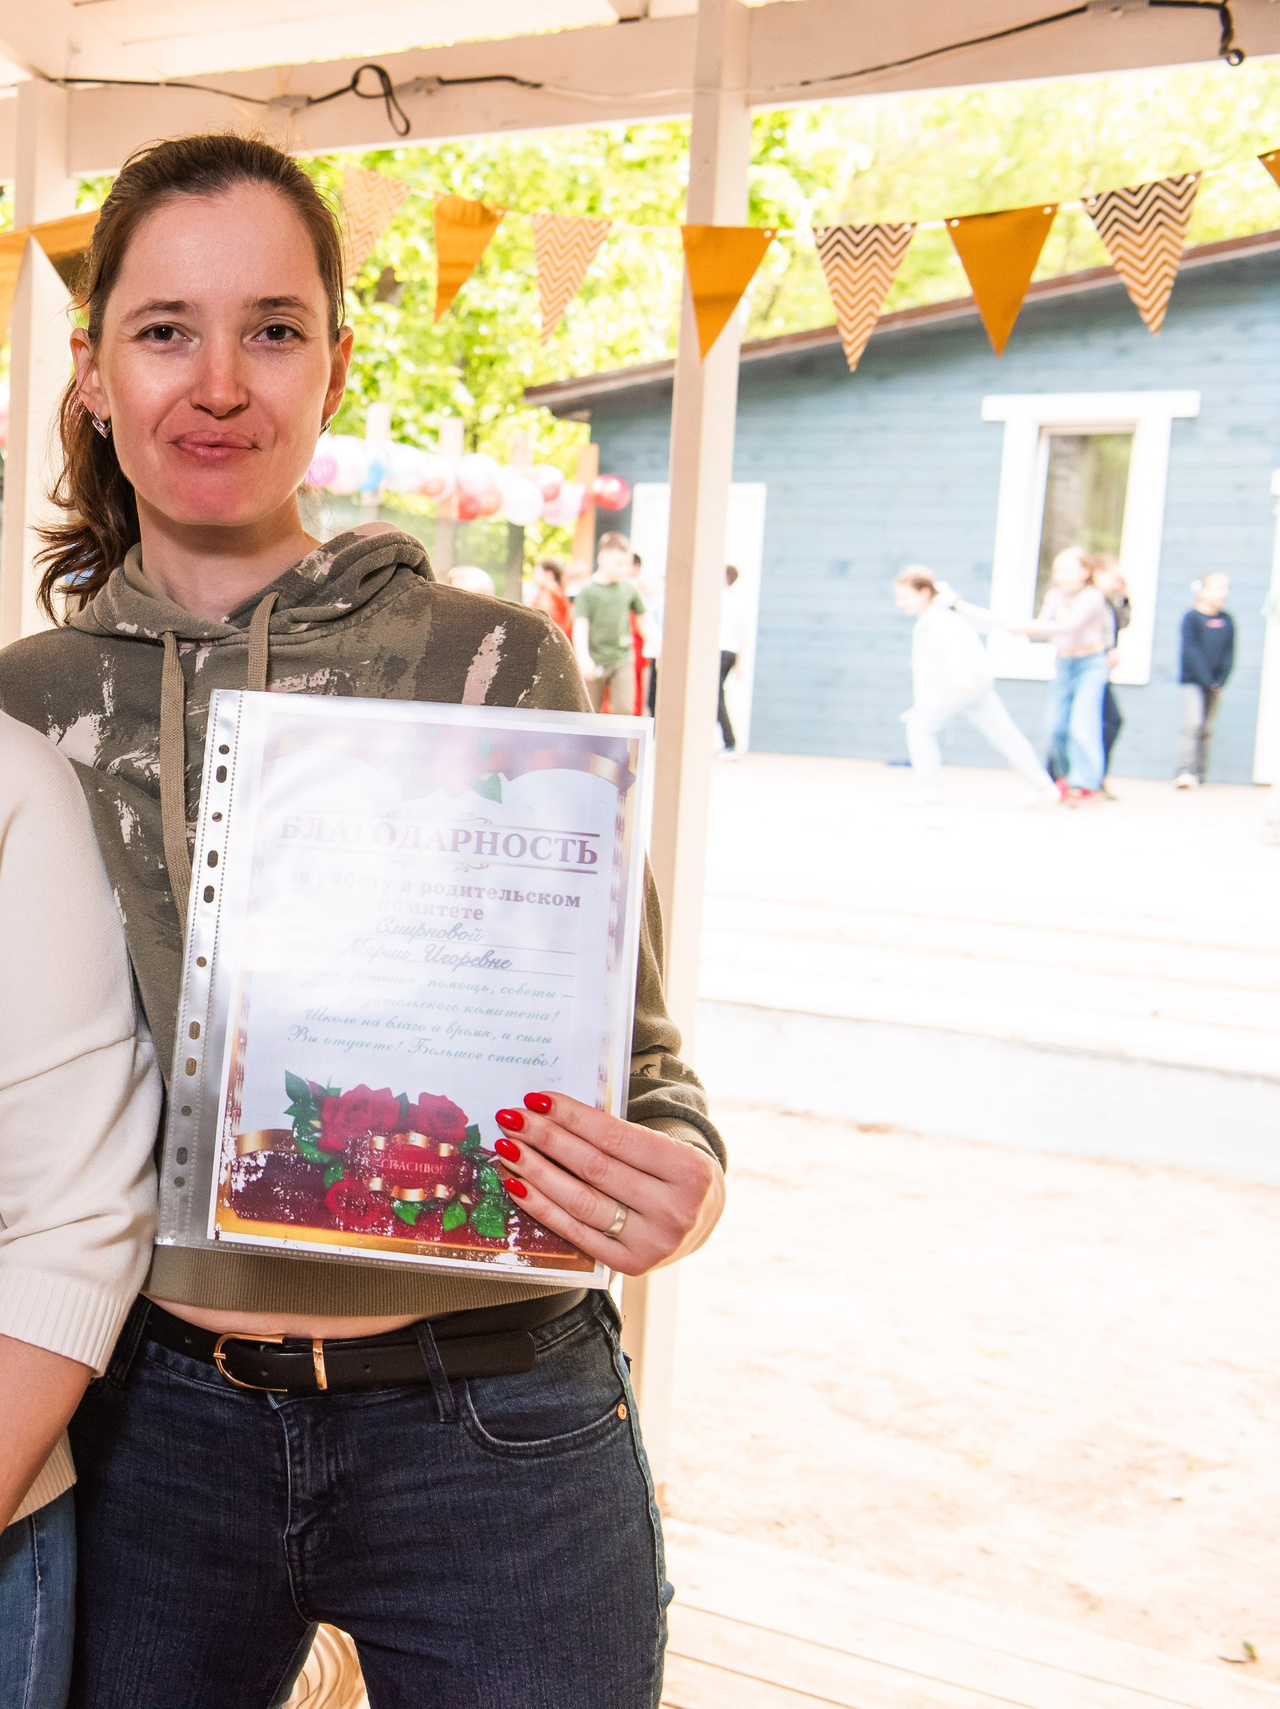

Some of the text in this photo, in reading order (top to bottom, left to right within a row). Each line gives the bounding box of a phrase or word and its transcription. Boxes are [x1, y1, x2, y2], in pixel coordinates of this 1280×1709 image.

[278, 815, 598, 865] БЛАГОДАРНОСТЬ
[401, 880, 412, 893] в
[420, 881, 582, 908] родительском
[376, 900, 484, 921] комитете
[375, 916, 484, 943] Смирновой
[424, 943, 513, 972] Игоревне
[427, 978, 495, 995] помощь,
[500, 981, 558, 999] советы
[463, 1004, 561, 1022] комитета!
[361, 1018, 381, 1028] на
[431, 1023, 443, 1033] и
[445, 1020, 496, 1041] время,
[501, 1031, 512, 1041] и
[516, 1034, 554, 1045] силы
[286, 1024, 319, 1044] Вы
[407, 1036, 484, 1060] Большое
[487, 1053, 560, 1068] спасибо!
